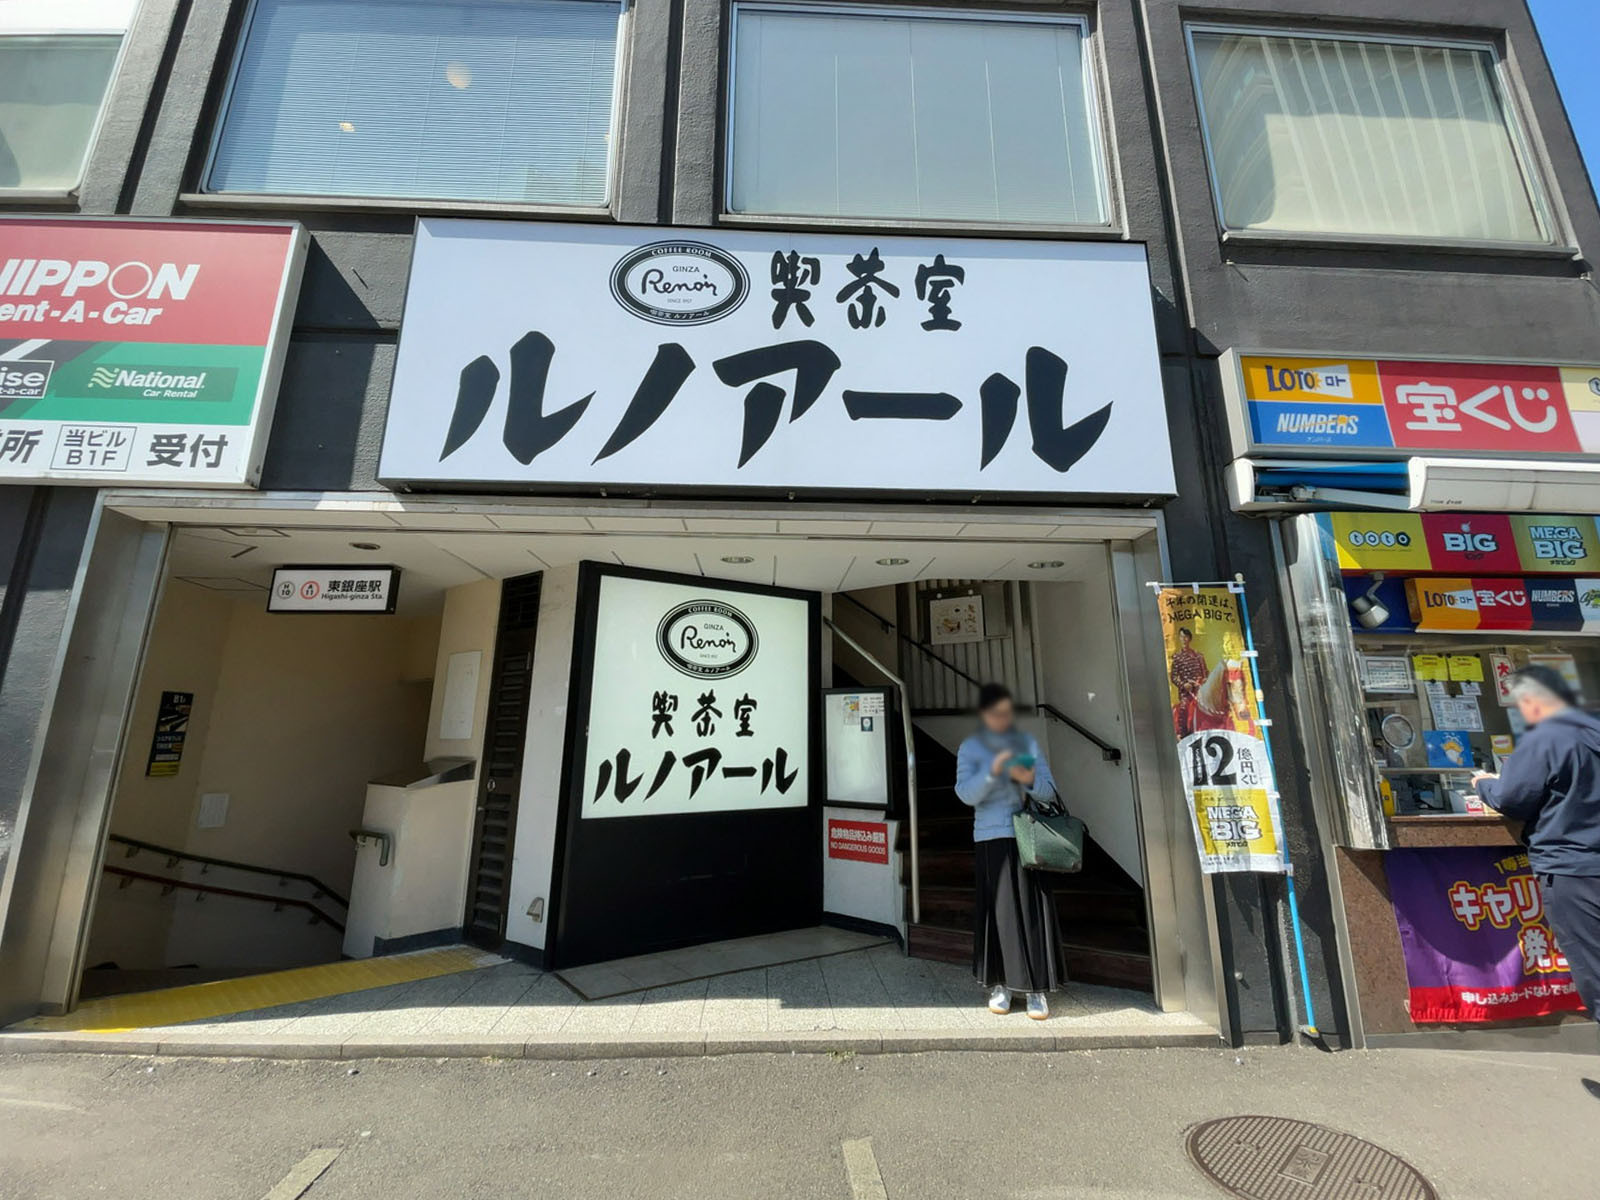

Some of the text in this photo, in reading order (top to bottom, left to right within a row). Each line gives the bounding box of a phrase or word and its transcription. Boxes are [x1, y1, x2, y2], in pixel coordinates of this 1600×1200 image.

[651, 247, 712, 257] COFFEE ROOM
[672, 265, 700, 273] GINZA
[641, 268, 718, 296] Renoir
[770, 247, 966, 332] 喫茶室
[117, 369, 204, 389] National
[1265, 364, 1315, 392] LOTO
[143, 389, 198, 398] Car Rental
[439, 331, 1114, 472] ルノアール
[1395, 381, 1558, 433] 宝くじ
[1277, 413, 1359, 434] NUMBERS
[0, 428, 44, 464] 所
[64, 429, 127, 449] 当ビル
[65, 450, 118, 466] B1F
[146, 433, 229, 469] 受付
[1350, 531, 1411, 547] toto
[1443, 533, 1498, 552] BIG
[1529, 526, 1583, 540] MEGA
[1533, 539, 1587, 559] BIG
[328, 580, 382, 593] 東銀座駅
[1531, 589, 1575, 603] NUMBERS
[1424, 590, 1455, 608] LOTO
[1476, 589, 1526, 607] 宝くじ
[1168, 608, 1203, 623] MEGA
[704, 623, 725, 631] GINZA
[680, 625, 737, 653] Renoir
[651, 689, 758, 739] 喫茶室
[1188, 735, 1237, 787] 12
[593, 747, 799, 805] ルノアール
[1206, 805, 1259, 820] MEGA
[1210, 820, 1263, 842] BIG
[830, 841, 886, 855] NO DANGEROUS GOODS
